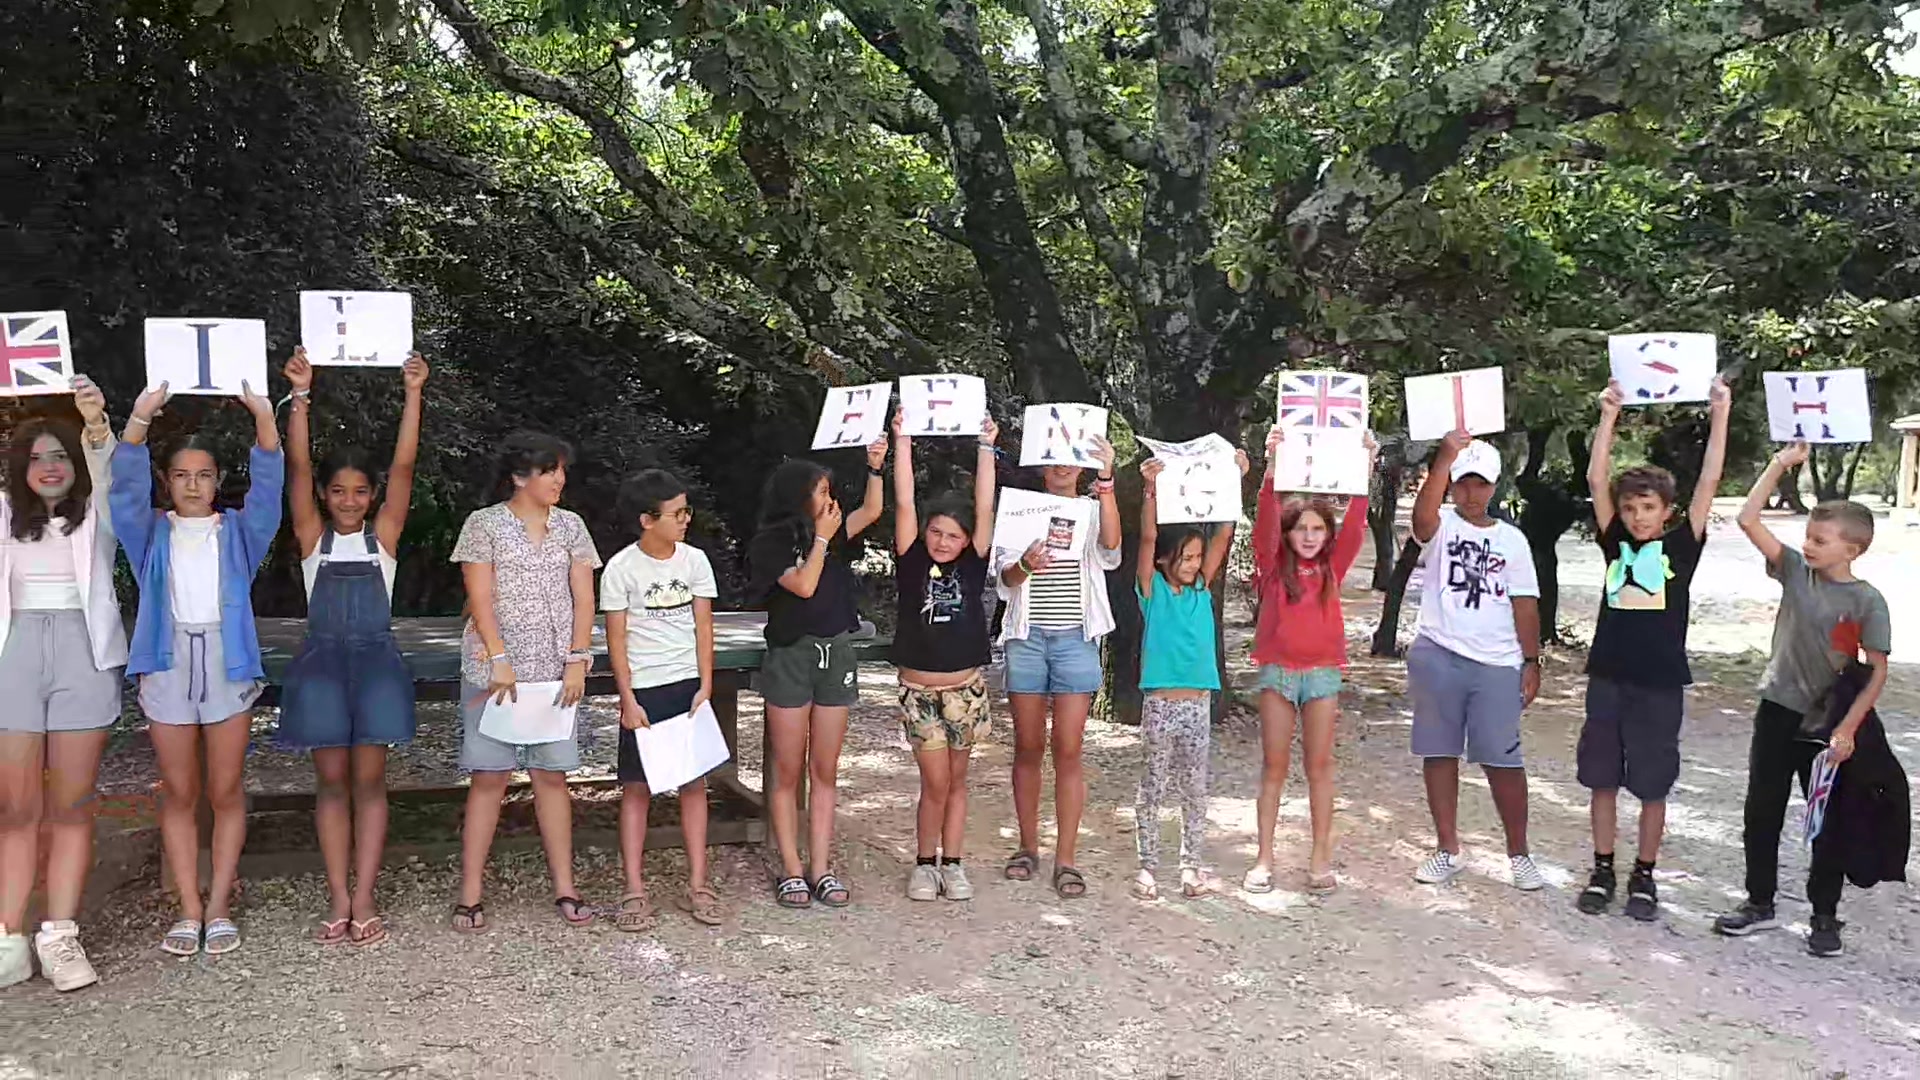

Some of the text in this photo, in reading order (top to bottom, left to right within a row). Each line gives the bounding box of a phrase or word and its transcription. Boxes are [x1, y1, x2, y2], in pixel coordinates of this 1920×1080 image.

[186, 322, 223, 390] I
[328, 295, 378, 362] L
[921, 378, 960, 432] E
[1040, 406, 1089, 462] N
[1786, 376, 1835, 439] H
